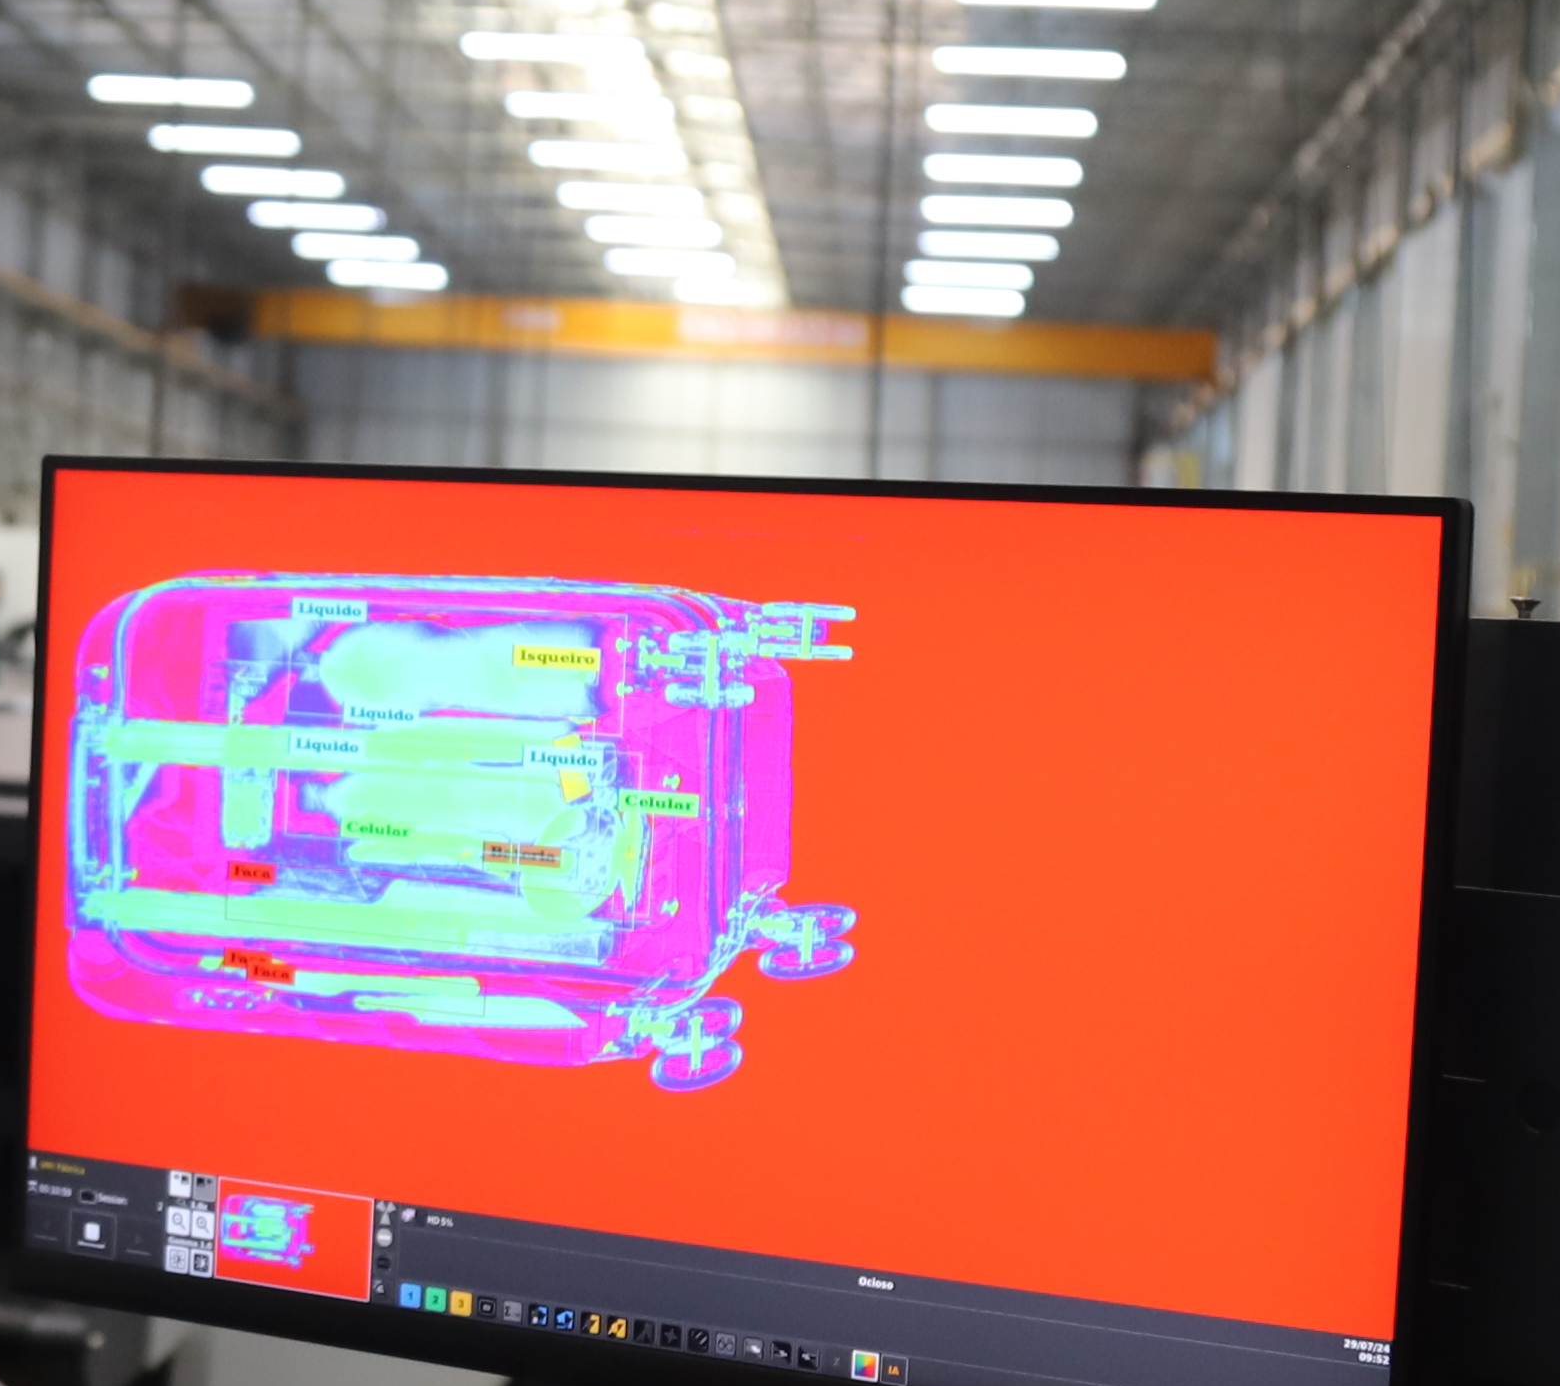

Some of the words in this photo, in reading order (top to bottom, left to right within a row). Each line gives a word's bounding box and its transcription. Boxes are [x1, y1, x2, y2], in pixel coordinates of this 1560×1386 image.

[520, 649, 596, 665] Isqueiro
[624, 794, 695, 812] Celular
[346, 821, 412, 838] Celular
[234, 865, 271, 879] Faca
[253, 966, 290, 980] Faca
[426, 1215, 440, 1226] HD
[858, 1276, 895, 1291] Ocioso
[1343, 1338, 1390, 1354] 29/07/24
[1358, 1352, 1390, 1365] 09:52
